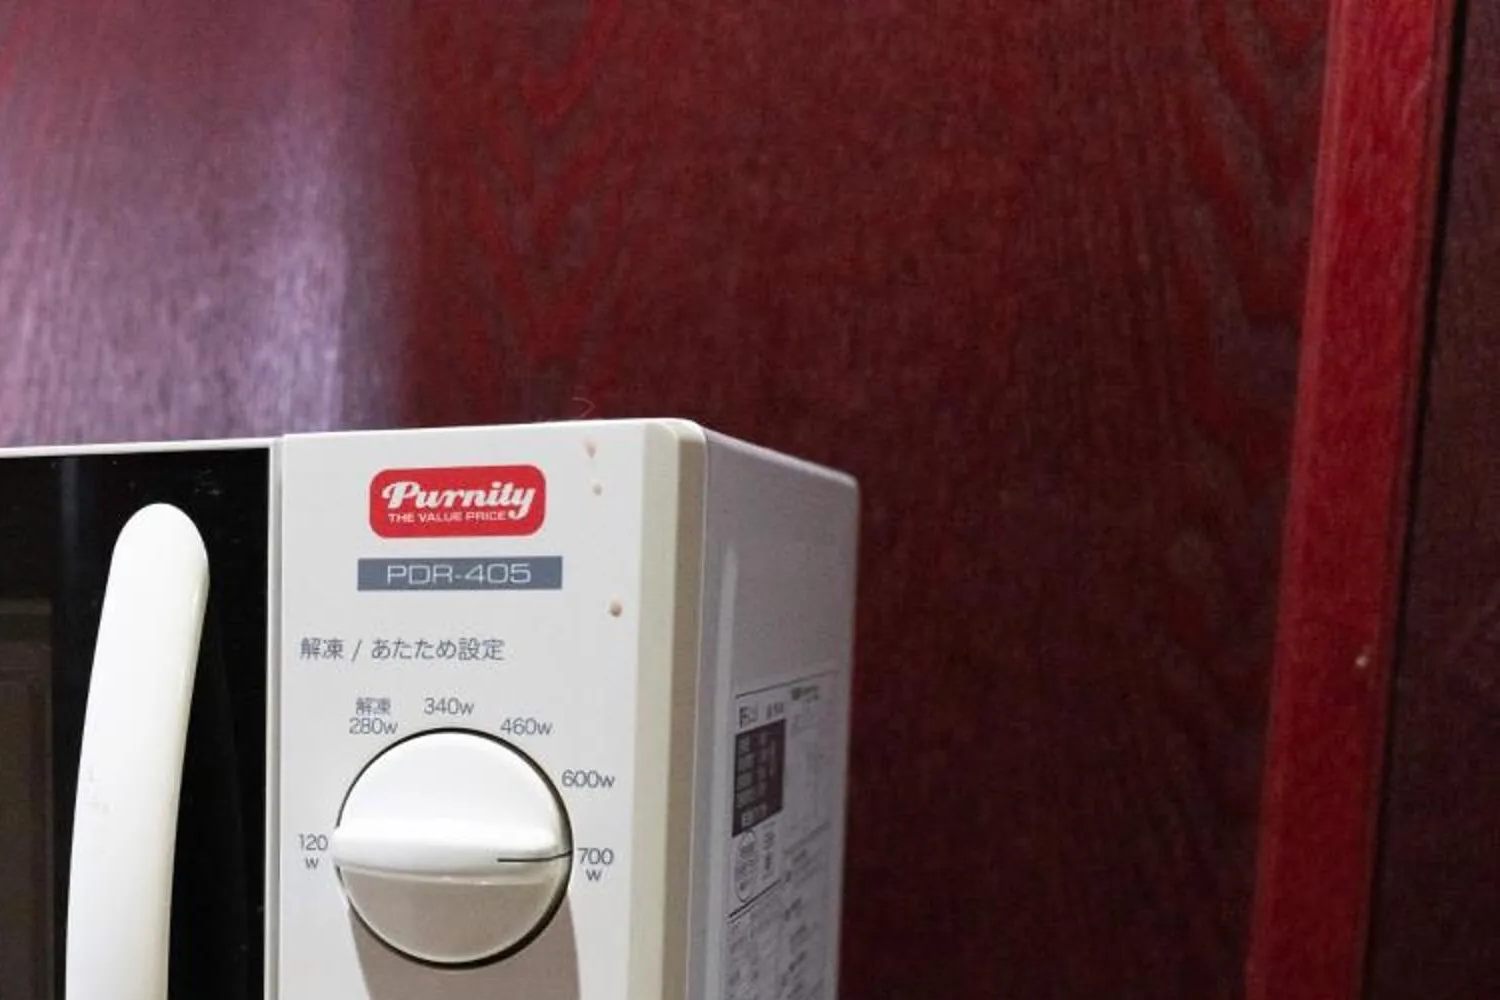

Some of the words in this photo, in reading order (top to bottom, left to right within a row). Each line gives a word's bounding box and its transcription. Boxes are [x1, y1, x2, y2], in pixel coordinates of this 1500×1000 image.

[381, 481, 536, 519] Purnity
[388, 513, 414, 524] THE
[418, 512, 462, 523] VALUE
[465, 511, 506, 522] PRICE
[387, 562, 531, 585] PDR-405
[300, 638, 344, 659] 解凍
[371, 638, 505, 661] あたため設定
[356, 698, 391, 715] 解凍
[424, 698, 474, 714] 340w
[349, 718, 398, 734] 280w
[501, 718, 552, 736] 460w
[561, 771, 615, 788] 600w
[299, 834, 328, 851] 120
[577, 848, 613, 865] 700
